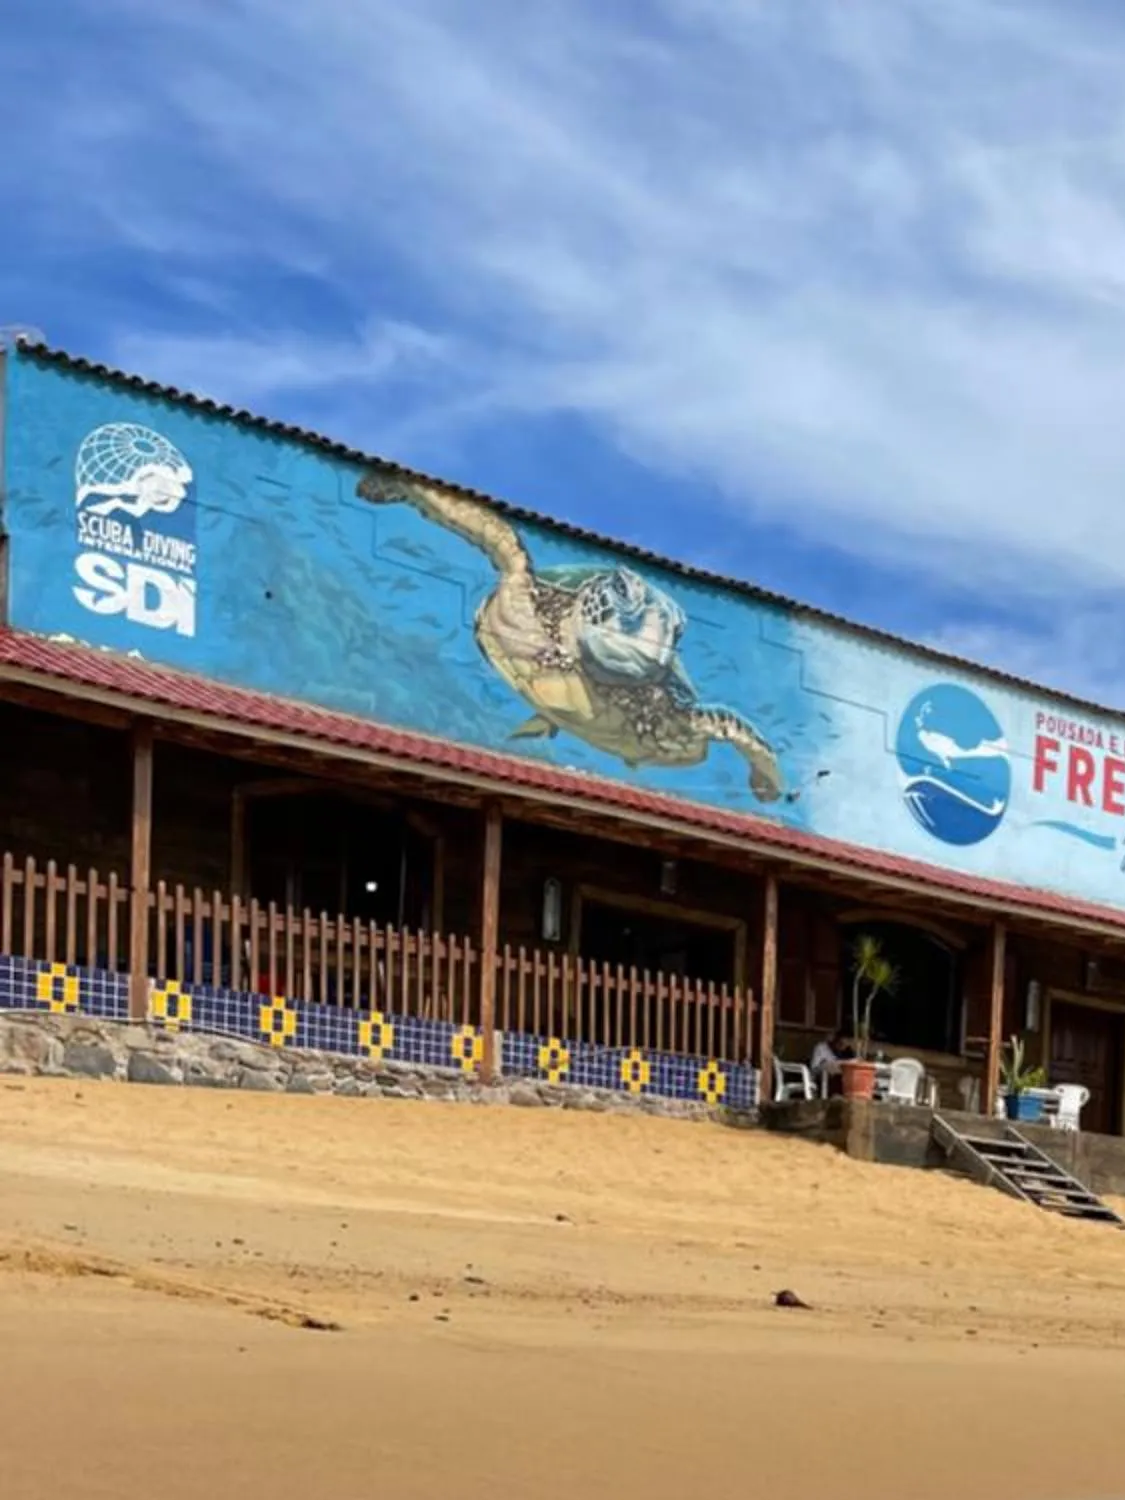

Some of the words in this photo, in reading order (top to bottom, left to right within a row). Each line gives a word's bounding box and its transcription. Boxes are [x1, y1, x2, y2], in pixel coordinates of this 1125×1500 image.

[78, 511, 134, 550] SCUBA
[143, 530, 197, 565] DIVING
[1035, 711, 1104, 749] POUSADA
[1109, 735, 1121, 753] E
